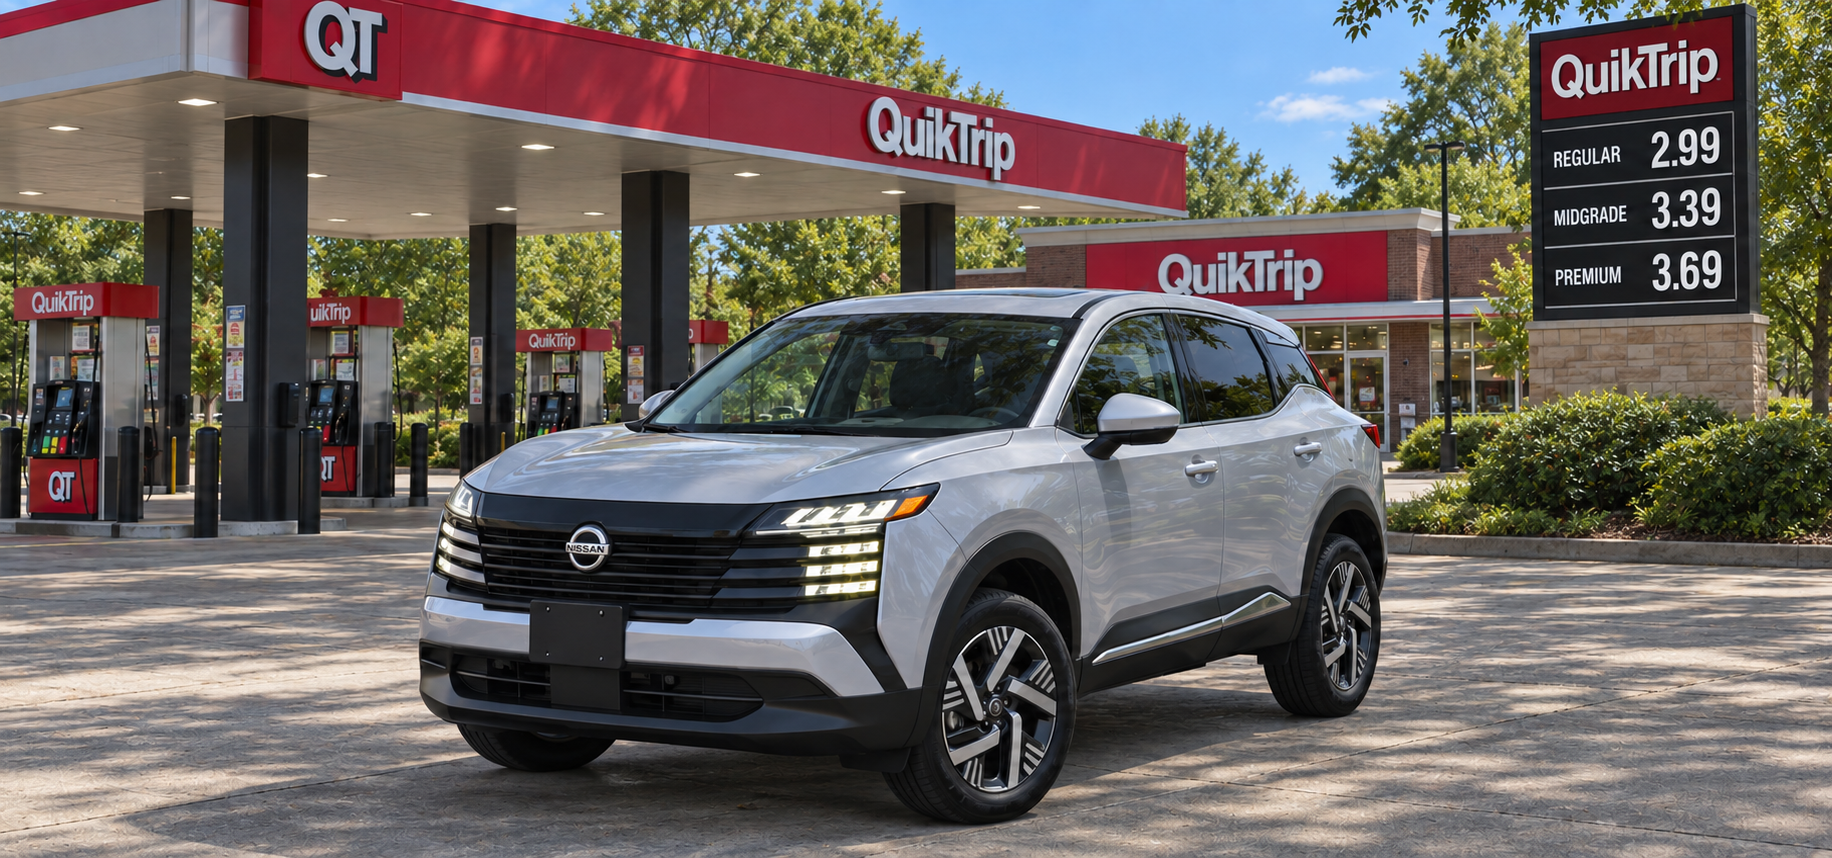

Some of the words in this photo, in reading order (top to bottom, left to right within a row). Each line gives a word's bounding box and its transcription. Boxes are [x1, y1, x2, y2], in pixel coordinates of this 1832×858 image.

[304, 0, 383, 77] QT
[1551, 40, 1718, 99] QuikTrip
[867, 96, 1016, 181] QuikTrip
[1553, 146, 1621, 168] REGULAR
[1651, 126, 1720, 169] 2.99
[1554, 205, 1627, 226] MIDGRADE
[1651, 187, 1721, 230] 3.39
[1158, 249, 1323, 300] QuikTrip
[1555, 266, 1622, 287] PREMIUM
[1652, 250, 1722, 291] 3.69
[31, 290, 94, 315] QuikTrip
[310, 303, 351, 325] uikTrip
[528, 332, 576, 350] QuikTrip
[48, 470, 76, 502] QT
[566, 544, 605, 554] NISSAN
